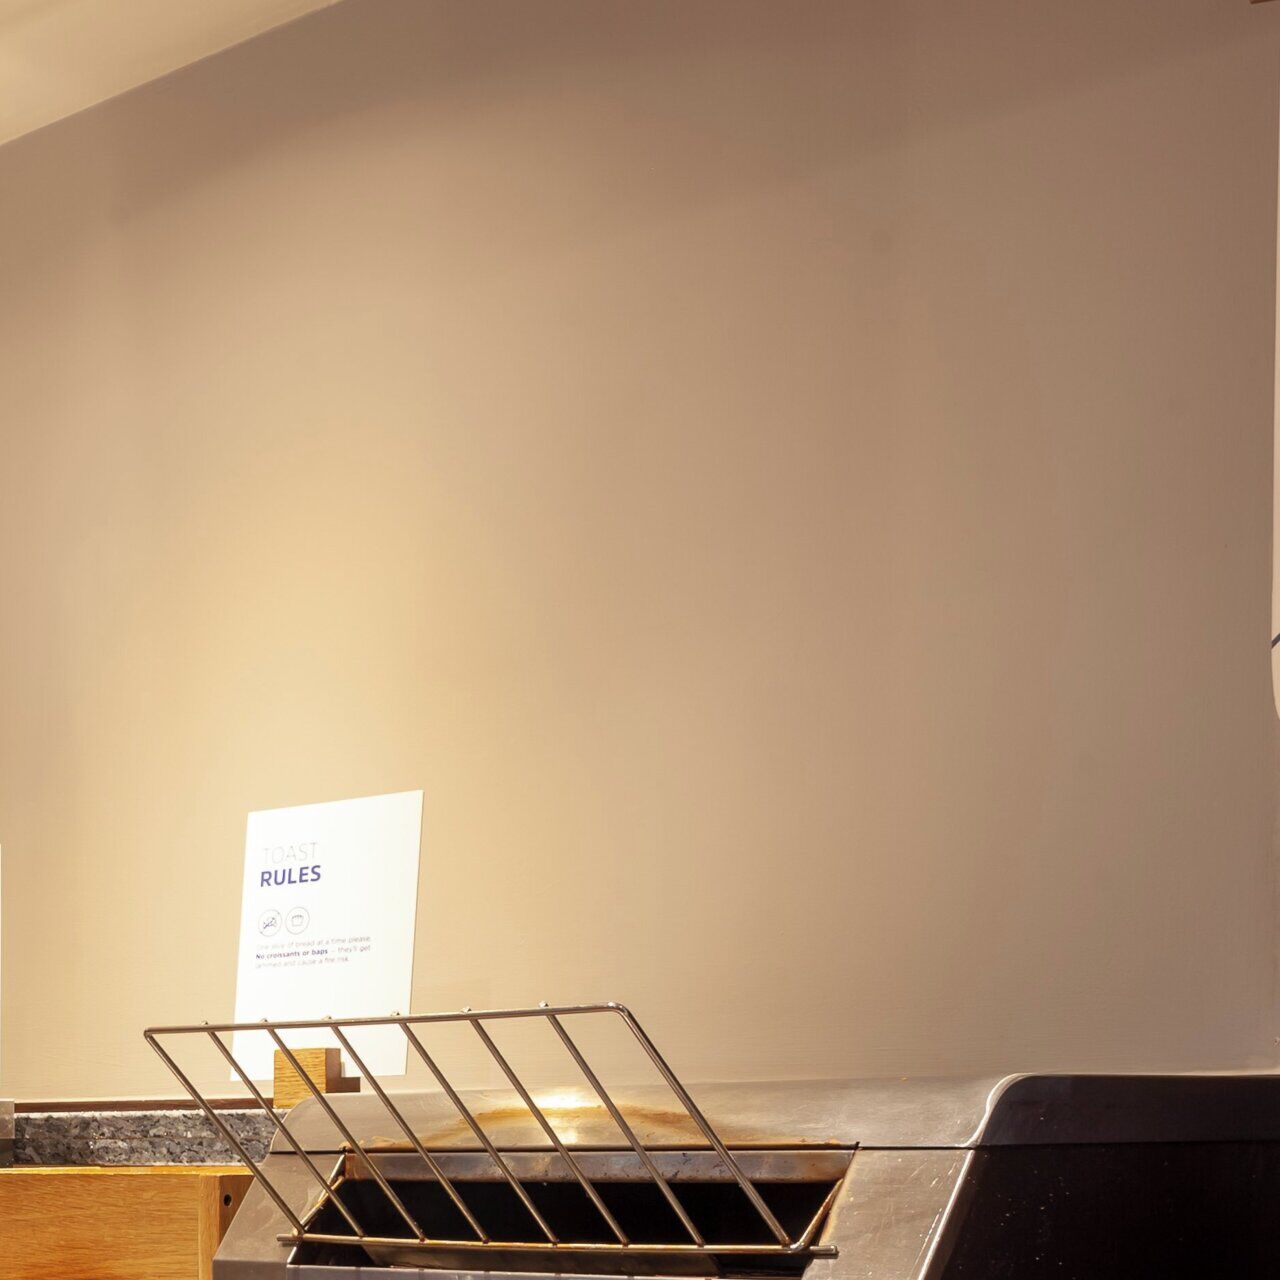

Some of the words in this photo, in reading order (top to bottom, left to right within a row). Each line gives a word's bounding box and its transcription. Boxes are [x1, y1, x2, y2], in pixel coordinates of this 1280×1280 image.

[262, 841, 319, 864] TOAST
[259, 865, 322, 887] RULES
[266, 950, 300, 959] croissants
